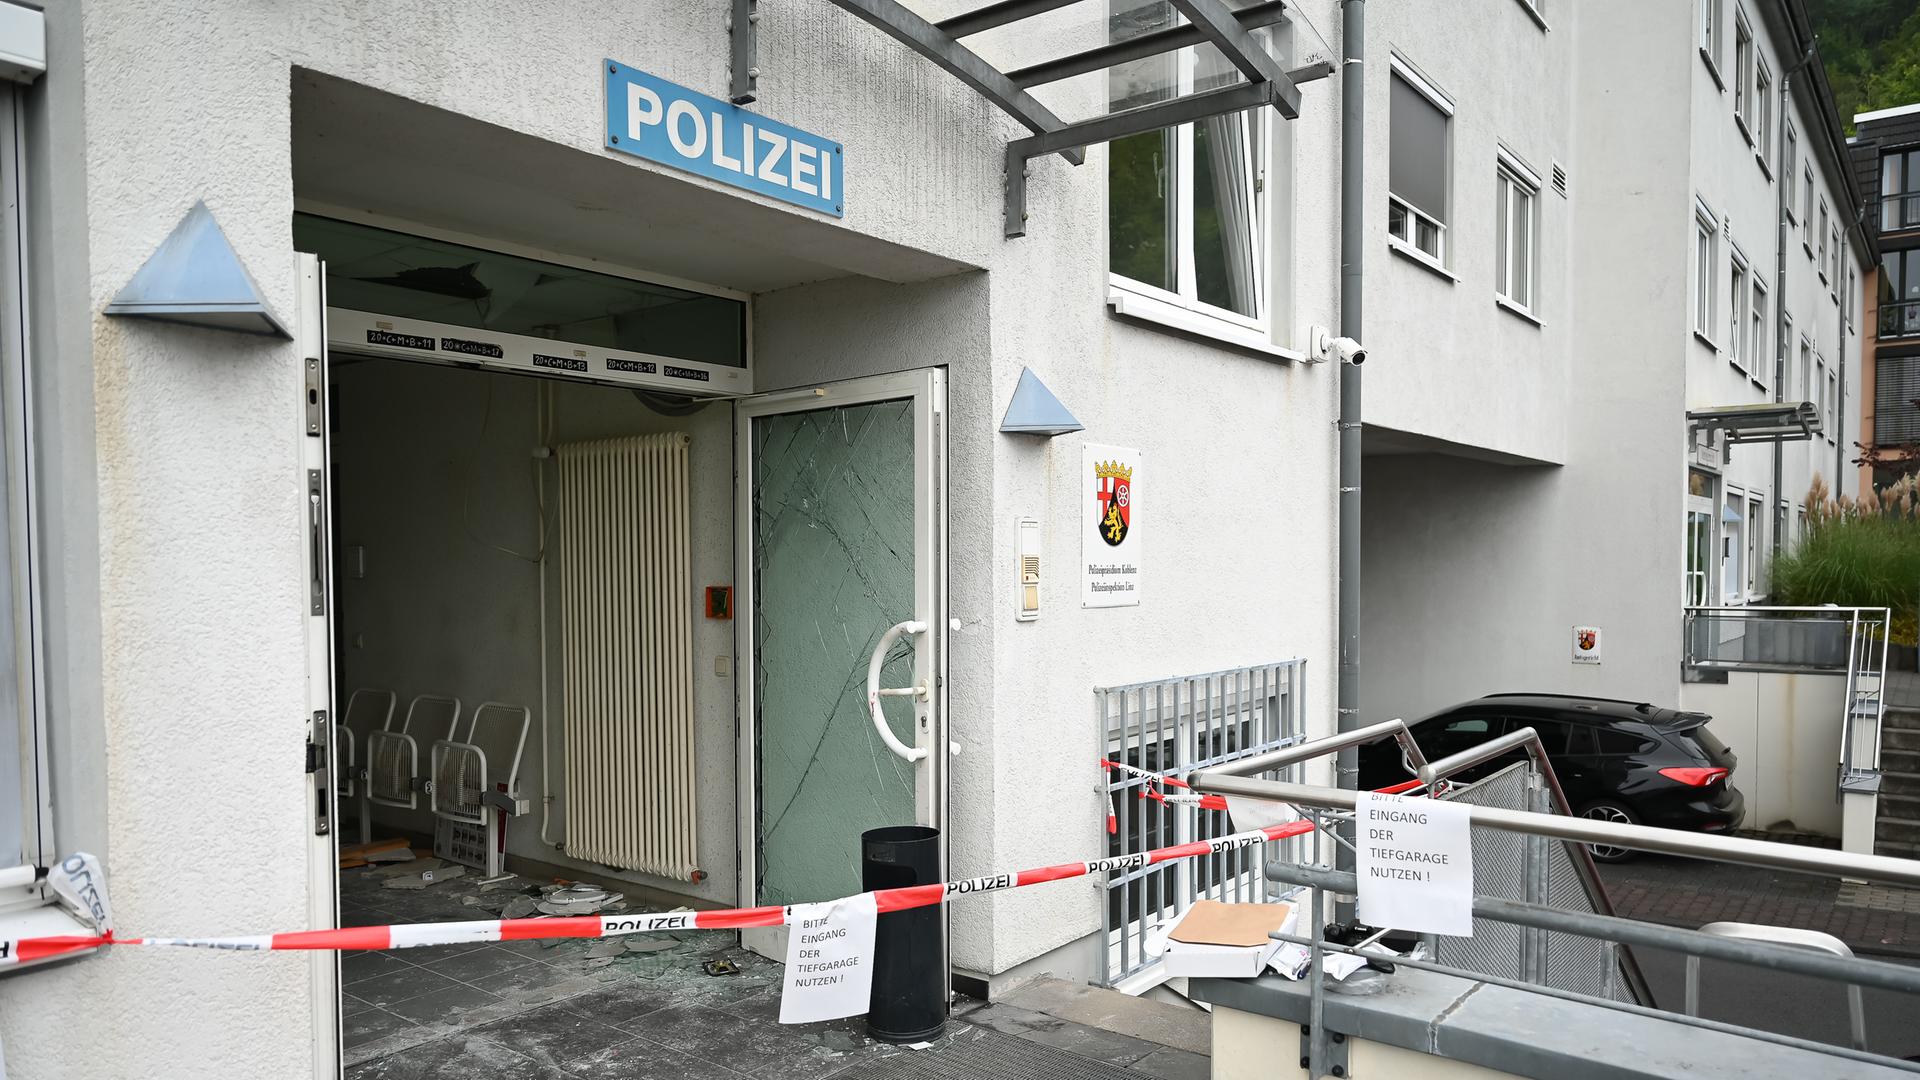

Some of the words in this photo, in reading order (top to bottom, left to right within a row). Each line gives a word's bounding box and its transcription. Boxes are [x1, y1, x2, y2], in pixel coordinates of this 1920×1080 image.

[627, 81, 831, 200] POLIZEI
[1369, 809, 1428, 825] EINGANG
[1369, 828, 1394, 841] DER
[1369, 847, 1449, 865] TIEFGARAGE
[1370, 866, 1422, 881] NUTZEN
[947, 873, 1010, 895] POLIZEI
[802, 917, 829, 929] BITTE
[801, 927, 846, 944] EINGANG
[799, 949, 821, 959] DER
[797, 956, 859, 973] TIEFGARAGE
[795, 975, 838, 987] NUTZEN
